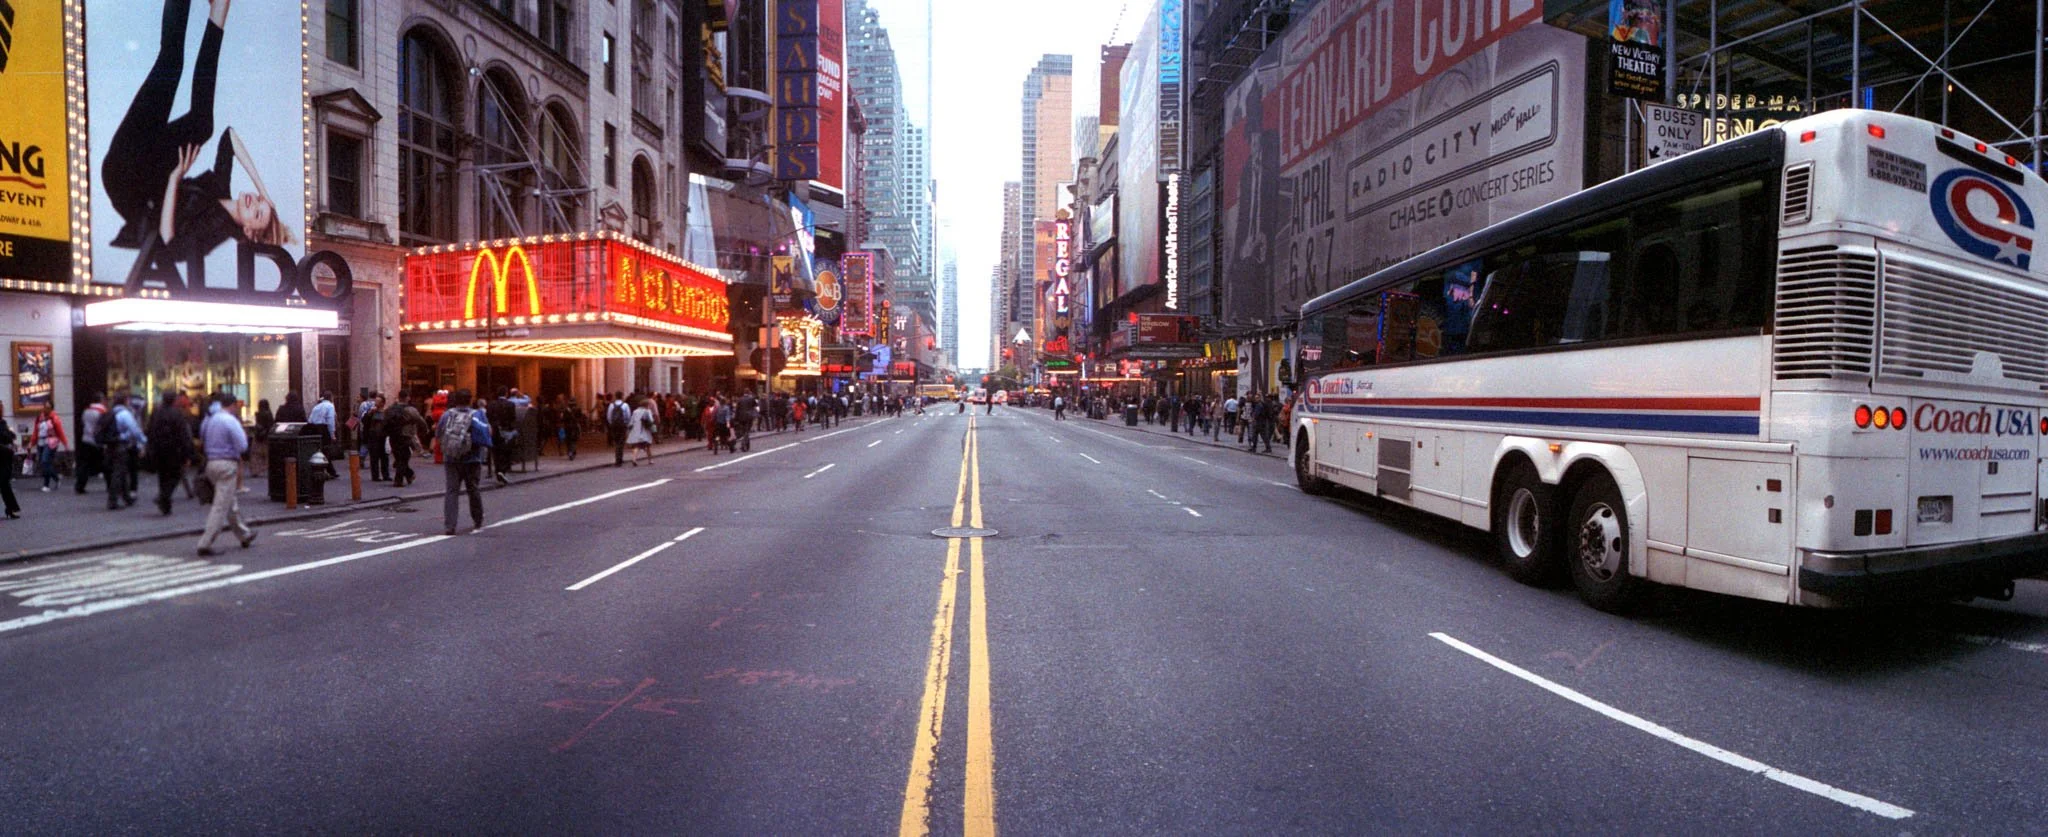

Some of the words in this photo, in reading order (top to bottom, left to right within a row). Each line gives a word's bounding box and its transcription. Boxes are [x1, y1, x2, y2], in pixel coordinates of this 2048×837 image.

[1611, 43, 1631, 57] NEW
[1632, 47, 1661, 64] VICTORY
[1617, 56, 1656, 76] THEATER
[1160, 52, 1181, 121] STUDIOS
[1280, 0, 1395, 163] LEONARD
[1491, 106, 1516, 137] MUSIC
[1654, 108, 1696, 127] BUSES
[1658, 125, 1692, 141] ONLY
[1160, 129, 1180, 168] DUKE
[1352, 155, 1413, 198] RADIO
[1426, 121, 1482, 165] CITY
[1291, 157, 1335, 237] APRIL
[1389, 196, 1437, 230] CHASE
[1456, 174, 1509, 209] CONCERT
[1511, 160, 1554, 192] SERIES
[126, 233, 352, 299] ALDO
[1055, 222, 1070, 313] REGAL
[1289, 241, 1299, 300] 6
[1304, 237, 1317, 297] &
[1325, 227, 1335, 291] 7
[815, 280, 842, 301] D&B
[1340, 378, 1354, 394] USA
[1913, 402, 1992, 434] Coach
[1995, 408, 2034, 437] USA
[1919, 445, 2029, 461] www.coachusa.com
